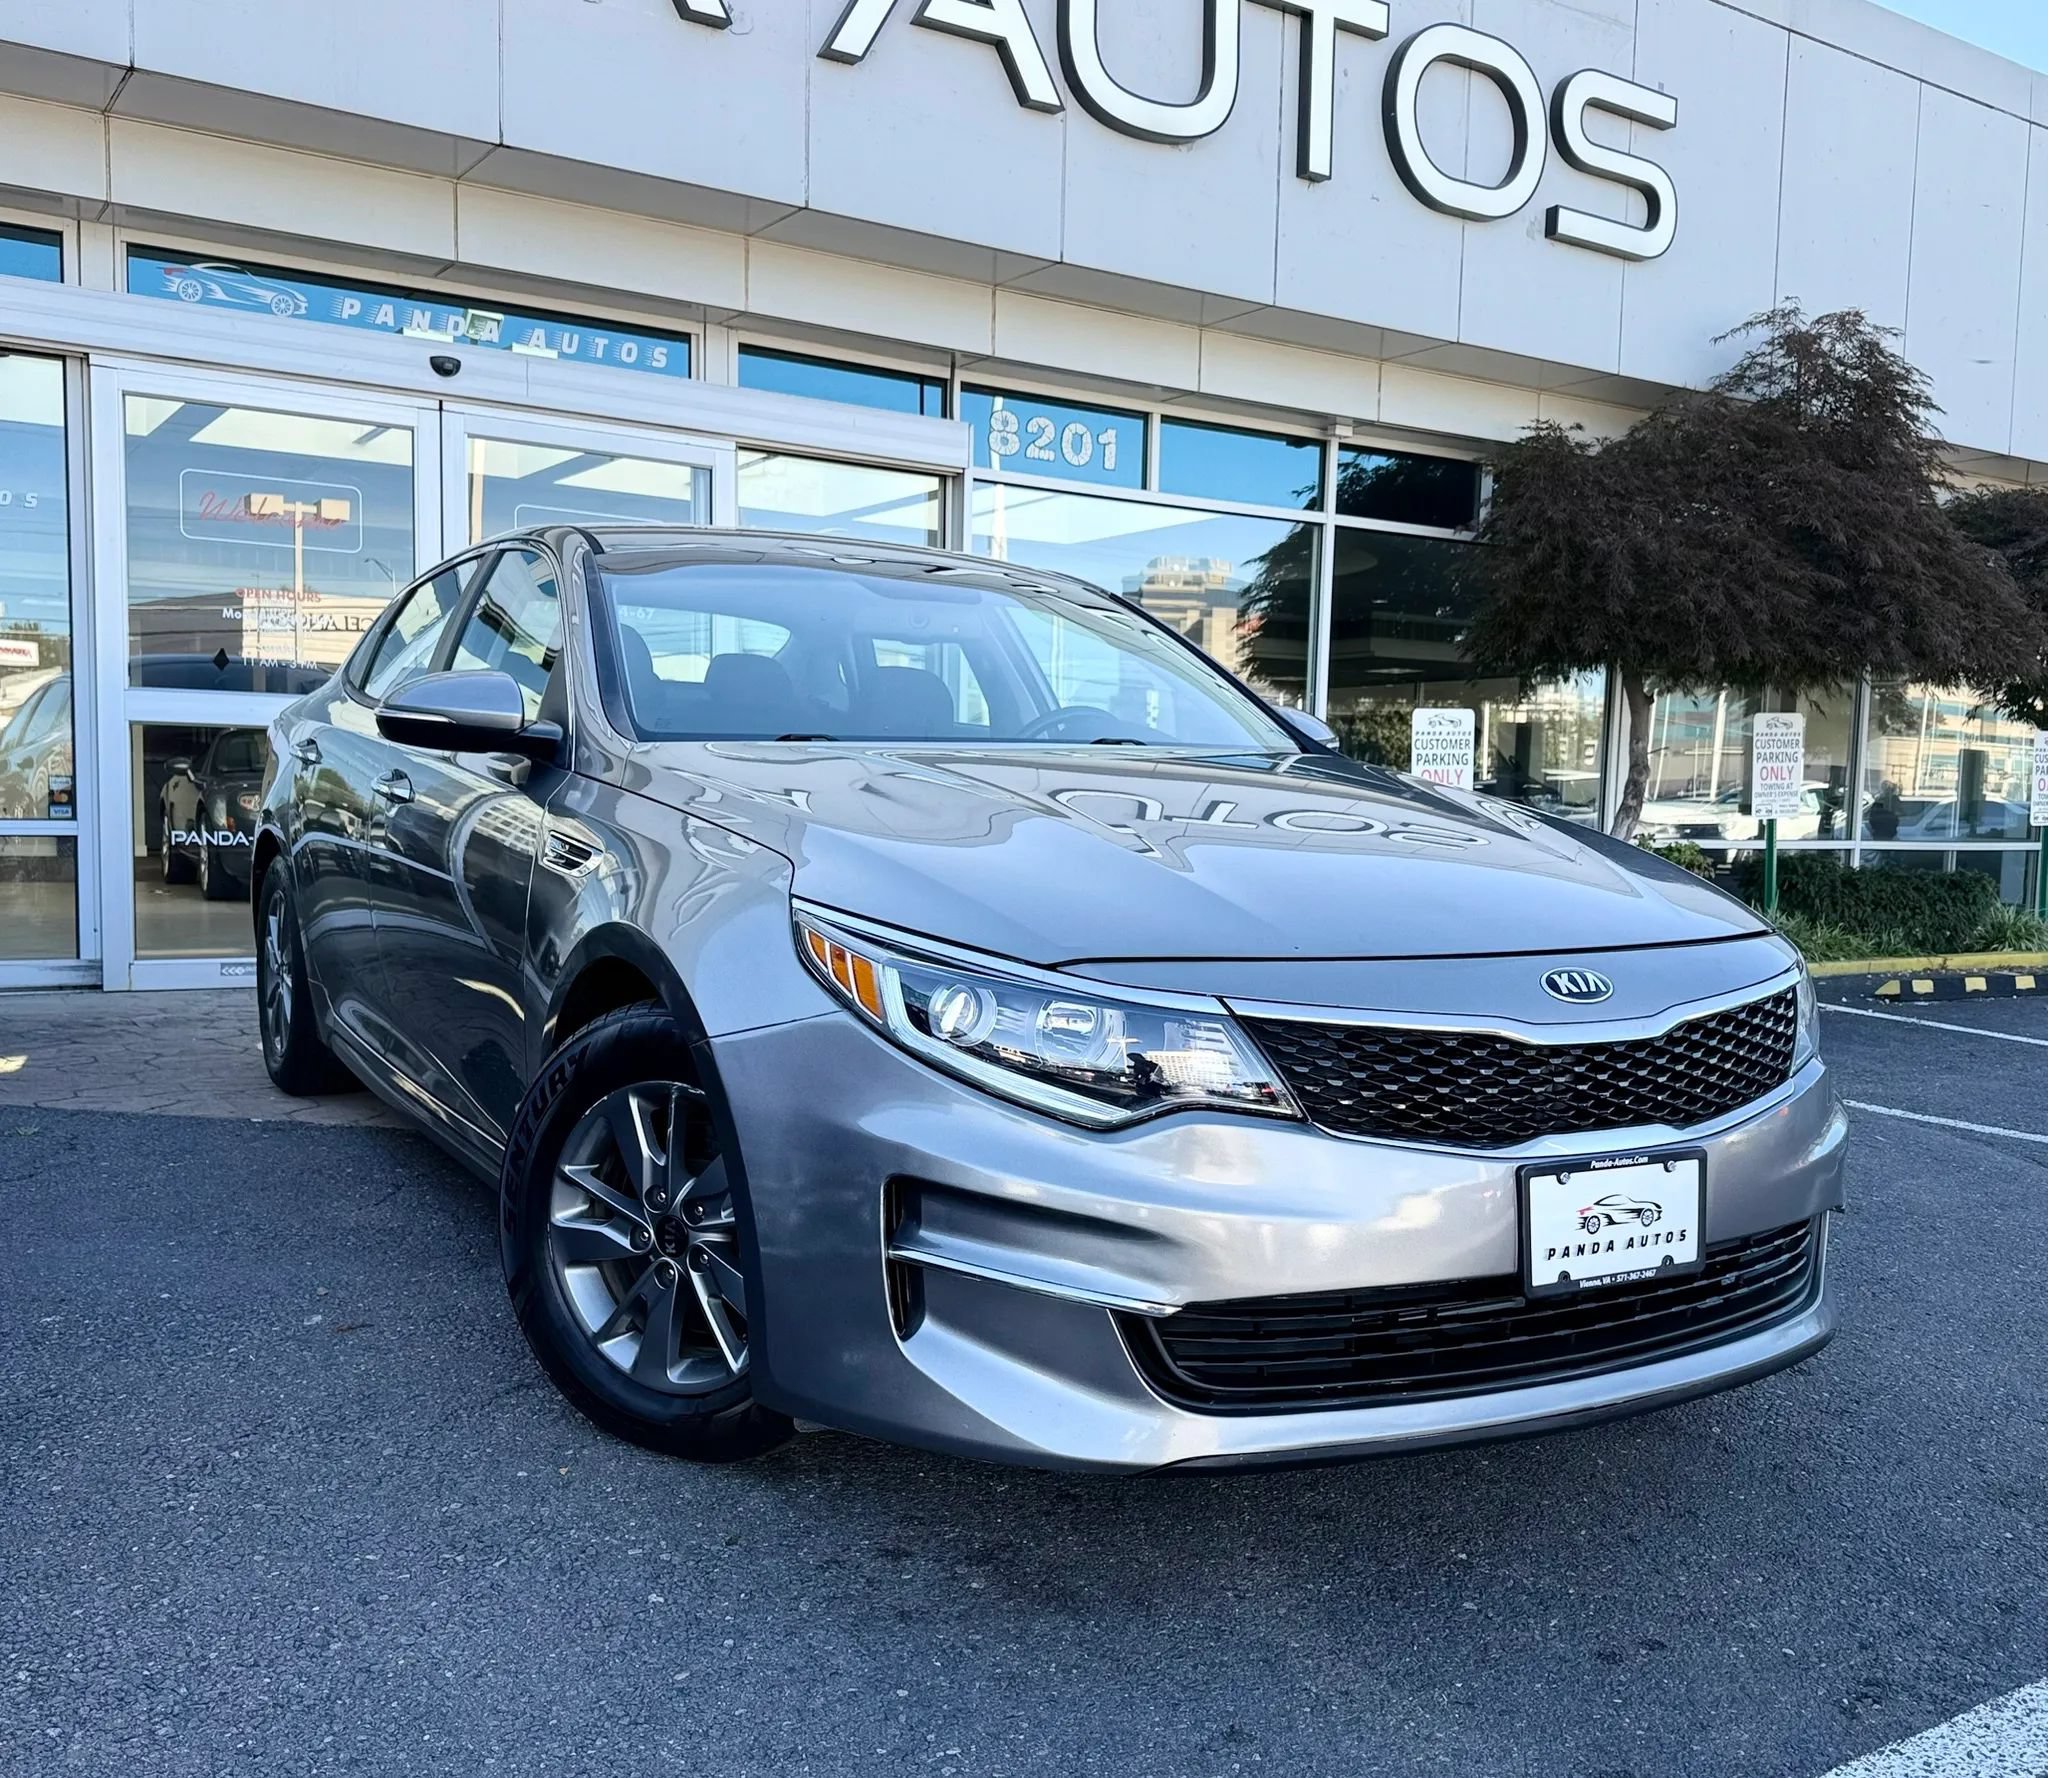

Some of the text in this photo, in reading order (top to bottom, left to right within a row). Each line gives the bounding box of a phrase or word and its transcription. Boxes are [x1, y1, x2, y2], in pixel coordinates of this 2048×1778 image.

[337, 296, 669, 369] PANDA AUTOS
[988, 409, 1117, 471] 8201
[234, 588, 322, 603] OPEN HOURS
[1414, 738, 1471, 750] CUSTOMER
[1755, 738, 1800, 750] CUSTOMER
[1416, 753, 1469, 766] PARKING
[1756, 751, 1798, 763] PARKING
[1760, 766, 1794, 780] ONLY
[1760, 782, 1794, 791] TOWING AT
[1550, 971, 1608, 994] KIA
[663, 1219, 677, 1254] KIA
[1546, 1229, 1687, 1261] PANDA AUTOS
[1602, 1276, 1611, 1284] VA
